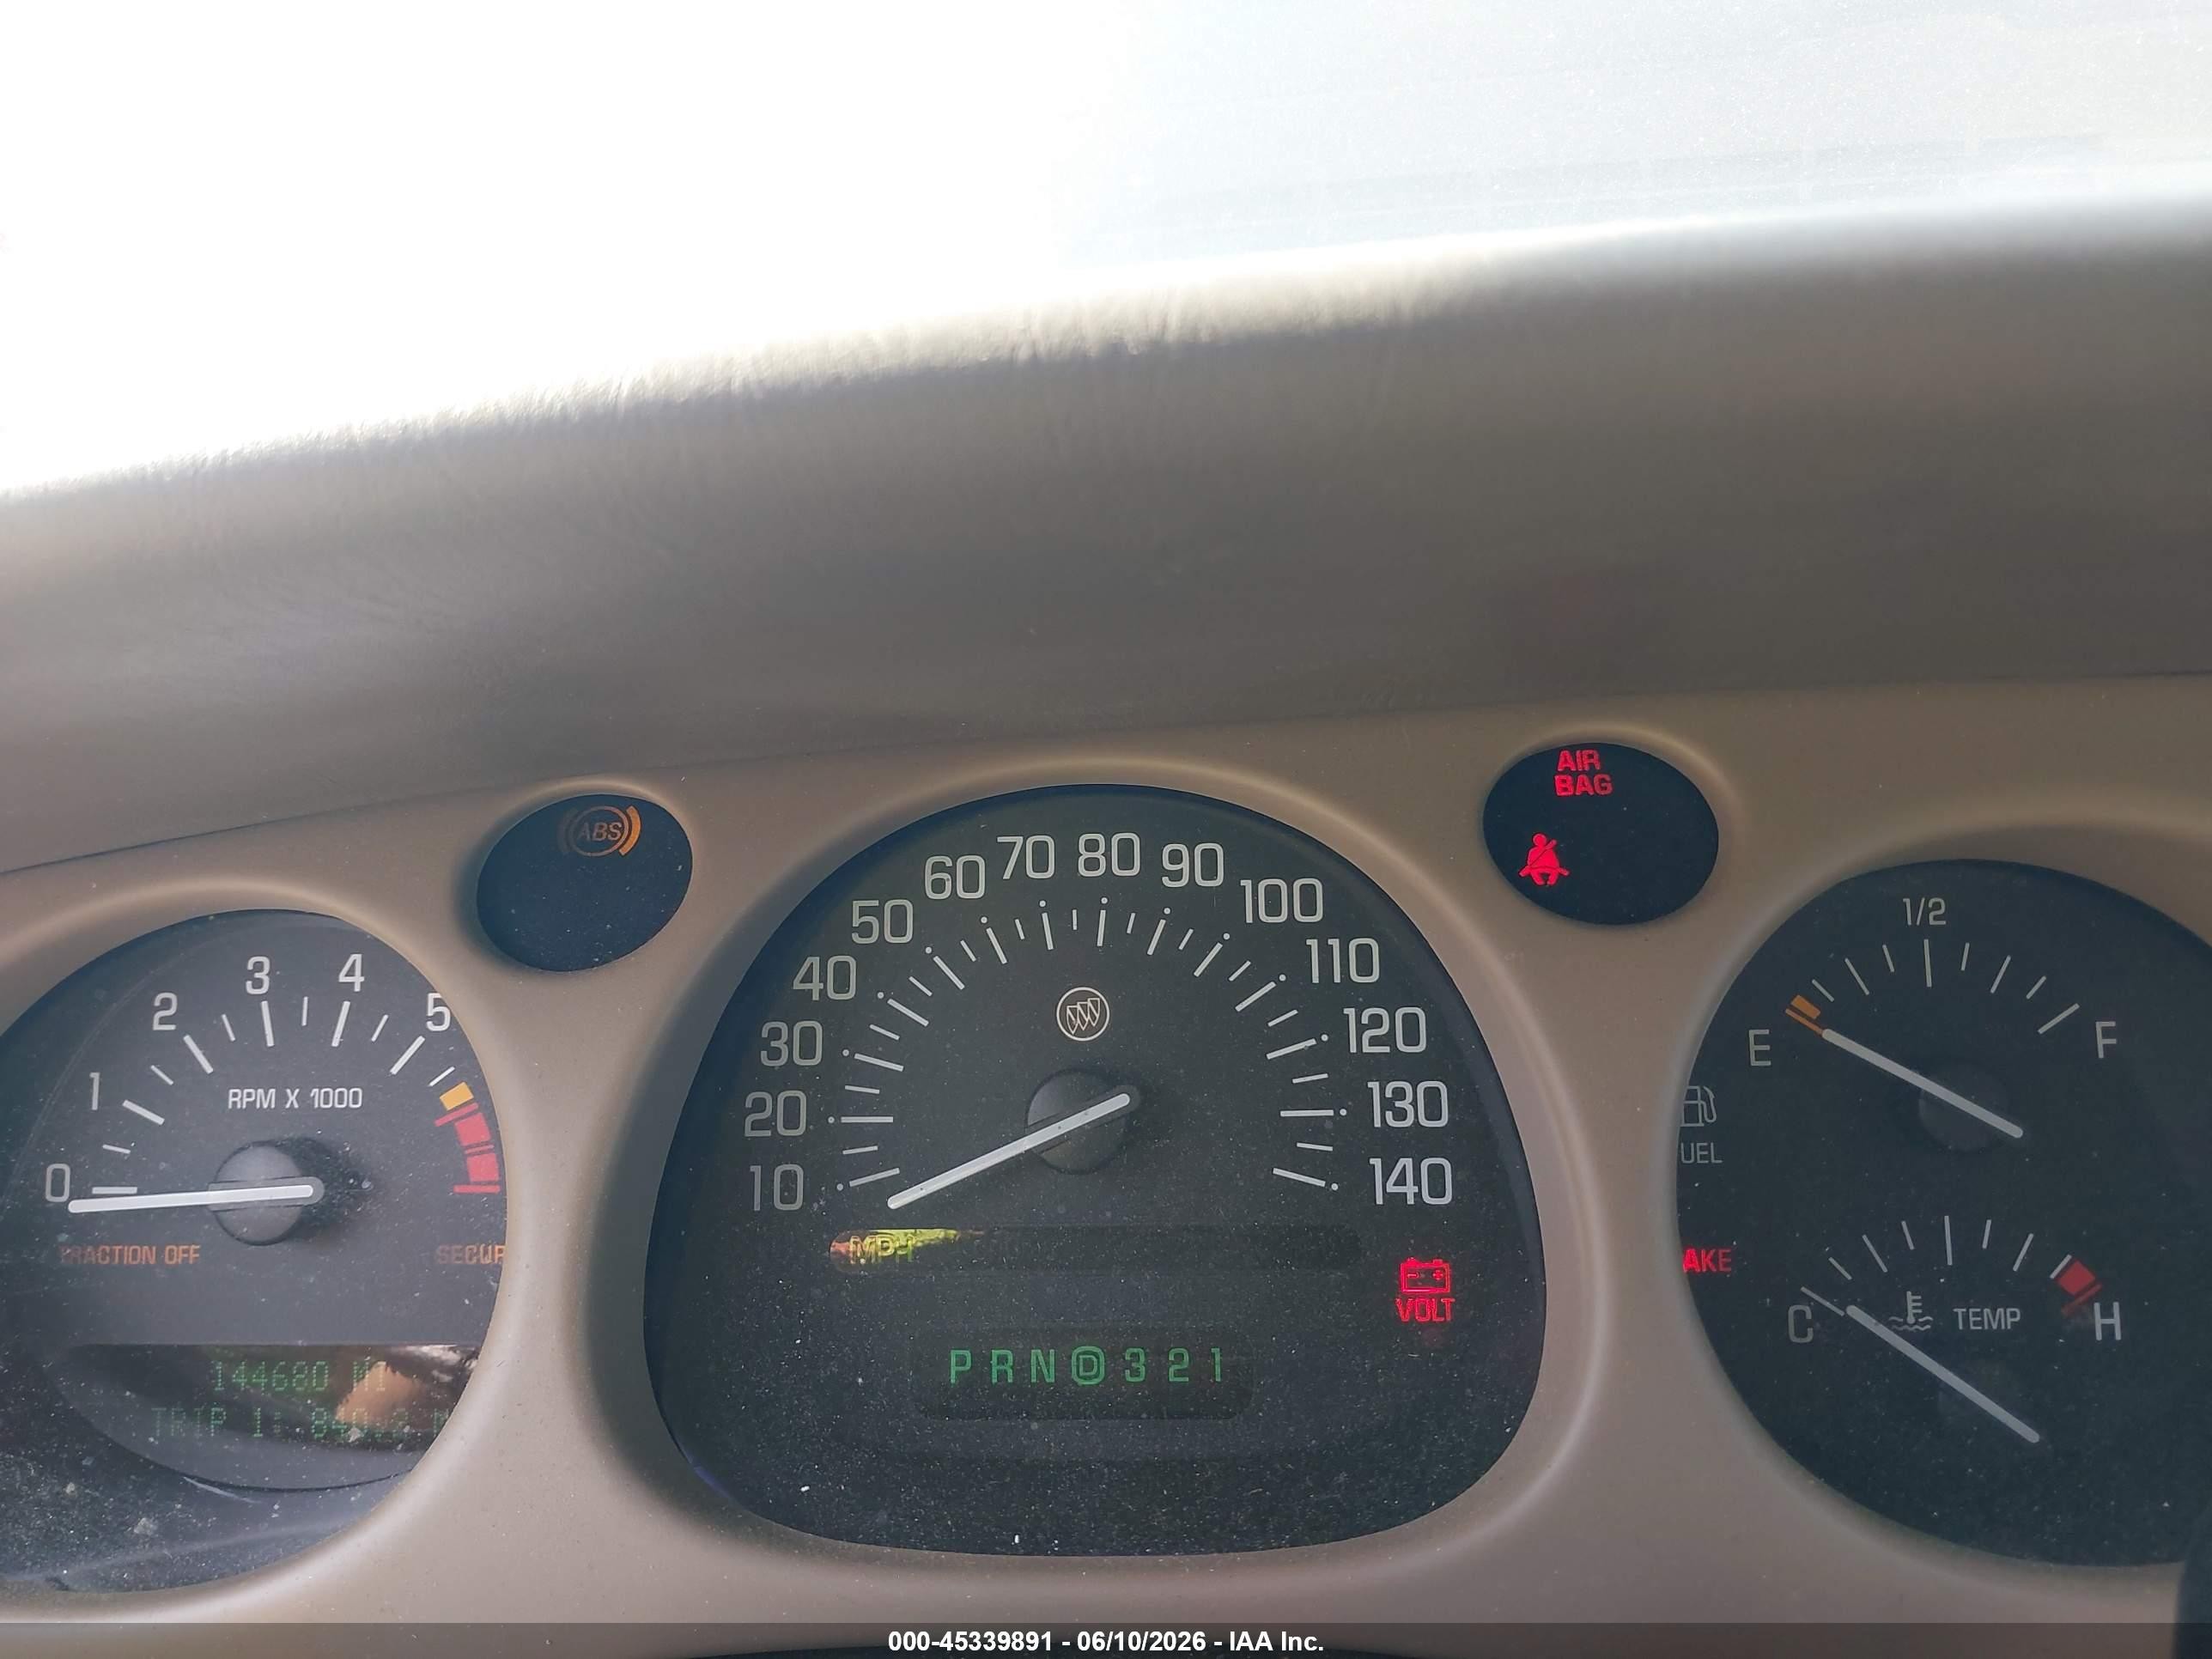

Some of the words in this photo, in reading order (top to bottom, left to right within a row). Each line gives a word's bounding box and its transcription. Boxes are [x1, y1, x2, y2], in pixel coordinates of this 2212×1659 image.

[1557, 750, 1601, 771] AIR
[1553, 774, 1613, 796] BAG
[577, 822, 623, 842] ABS
[997, 835, 1055, 879] 70
[1078, 832, 1140, 877] 80
[1161, 842, 1224, 888] 90
[925, 855, 986, 899] 60
[1240, 878, 1324, 923] 100
[1902, 897, 1948, 927] 1/2
[851, 899, 914, 944] 50
[246, 956, 270, 995] 3
[338, 953, 365, 992] 4
[793, 956, 857, 1000] 40
[1306, 938, 1380, 983] 110
[153, 993, 178, 1031] 2
[426, 993, 451, 1031] 5
[1344, 1007, 1427, 1054] 120
[760, 1021, 823, 1066] 30
[1748, 1029, 1771, 1066] E
[2094, 1020, 2118, 1059] F
[88, 1073, 101, 1110] 1
[228, 1088, 276, 1109] RPM
[285, 1088, 300, 1109] X
[310, 1087, 363, 1109] 1000
[1368, 1081, 1449, 1127] 130
[744, 1091, 806, 1137] 20
[46, 1164, 70, 1202] 0
[749, 1164, 804, 1211] 10
[1370, 1158, 1453, 1205] 140
[164, 1244, 201, 1265] OFF
[1395, 1297, 1455, 1322] VOLT
[1788, 1305, 1814, 1342] C
[1954, 1308, 2021, 1330] TEMP
[2094, 1302, 2122, 1340] H
[211, 1360, 329, 1391] 144680
[353, 1360, 386, 1391] MI
[950, 1349, 972, 1383] P
[991, 1349, 1014, 1383] R
[1030, 1349, 1055, 1382] N
[1124, 1347, 1146, 1382] 3
[1168, 1347, 1190, 1382] 2
[1211, 1347, 1222, 1382] 1
[151, 1407, 227, 1437] TRIP
